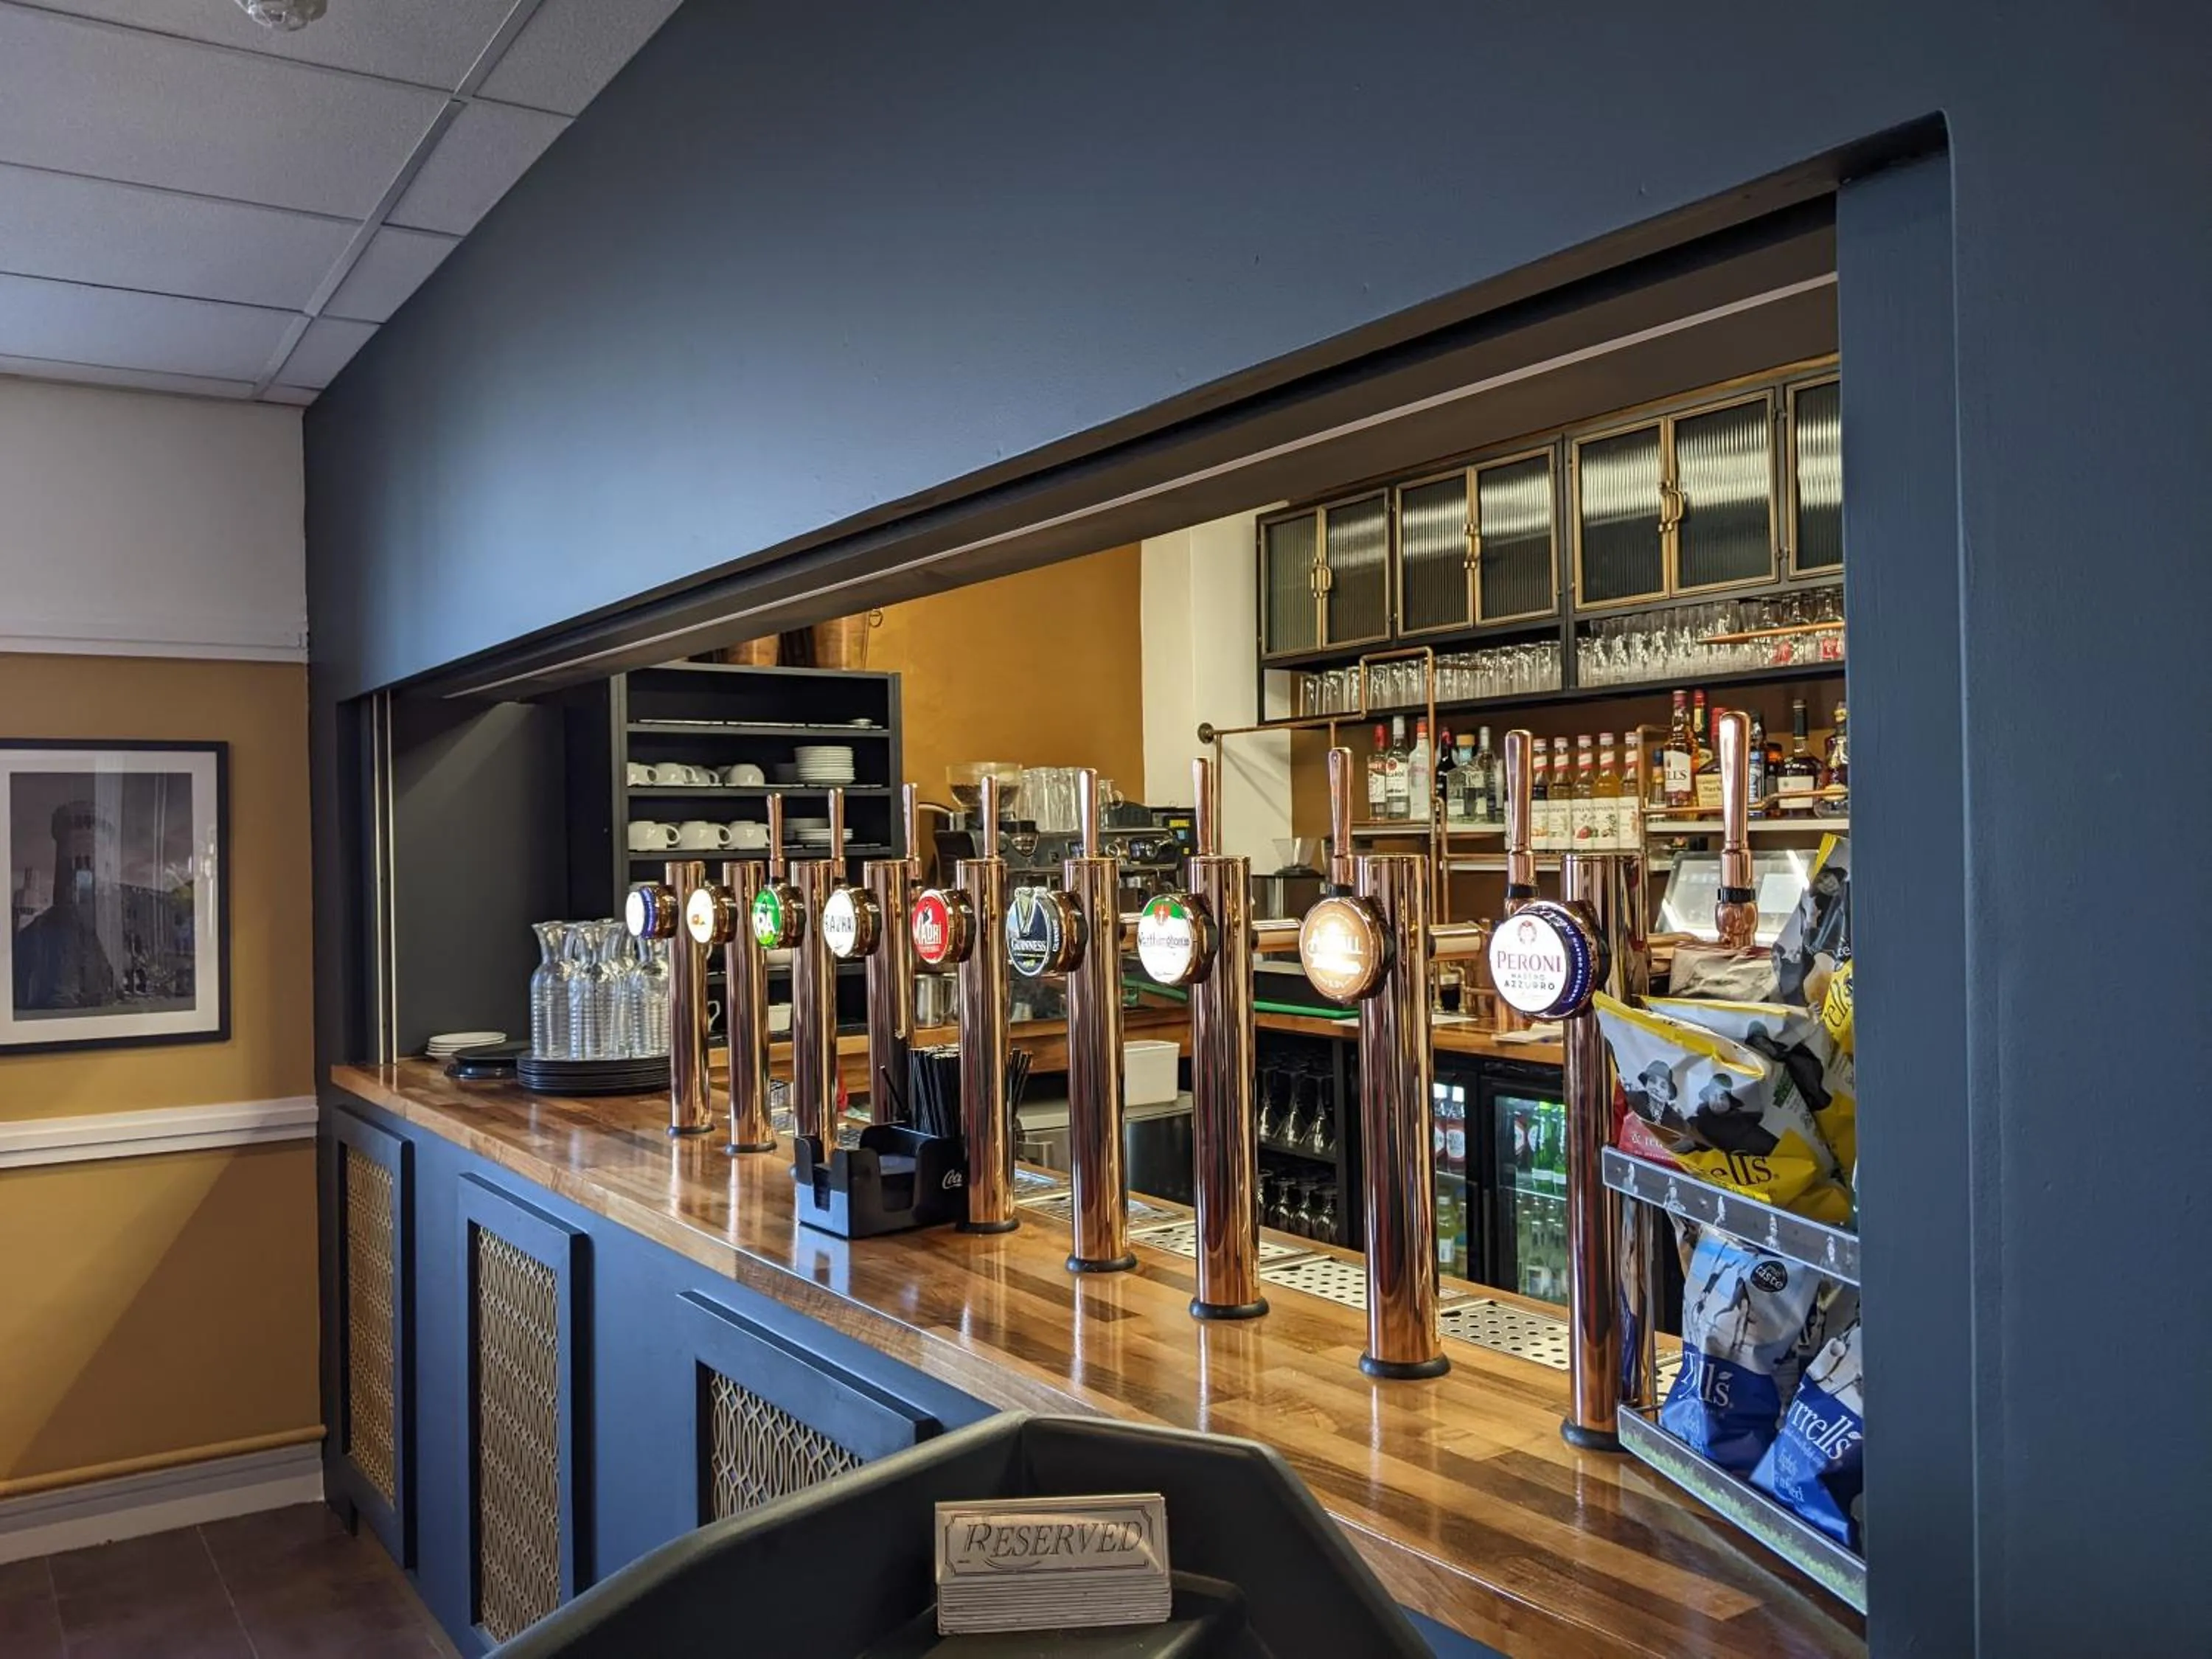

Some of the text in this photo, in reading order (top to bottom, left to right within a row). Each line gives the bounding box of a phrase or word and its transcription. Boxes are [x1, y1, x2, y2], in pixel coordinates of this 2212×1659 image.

[1011, 937, 1047, 952] GUINNESS
[1497, 950, 1562, 973] PERONI
[1504, 980, 1556, 991] AZZURRO
[1755, 1265, 1784, 1290] taste
[963, 1521, 1143, 1557] RESERVED
